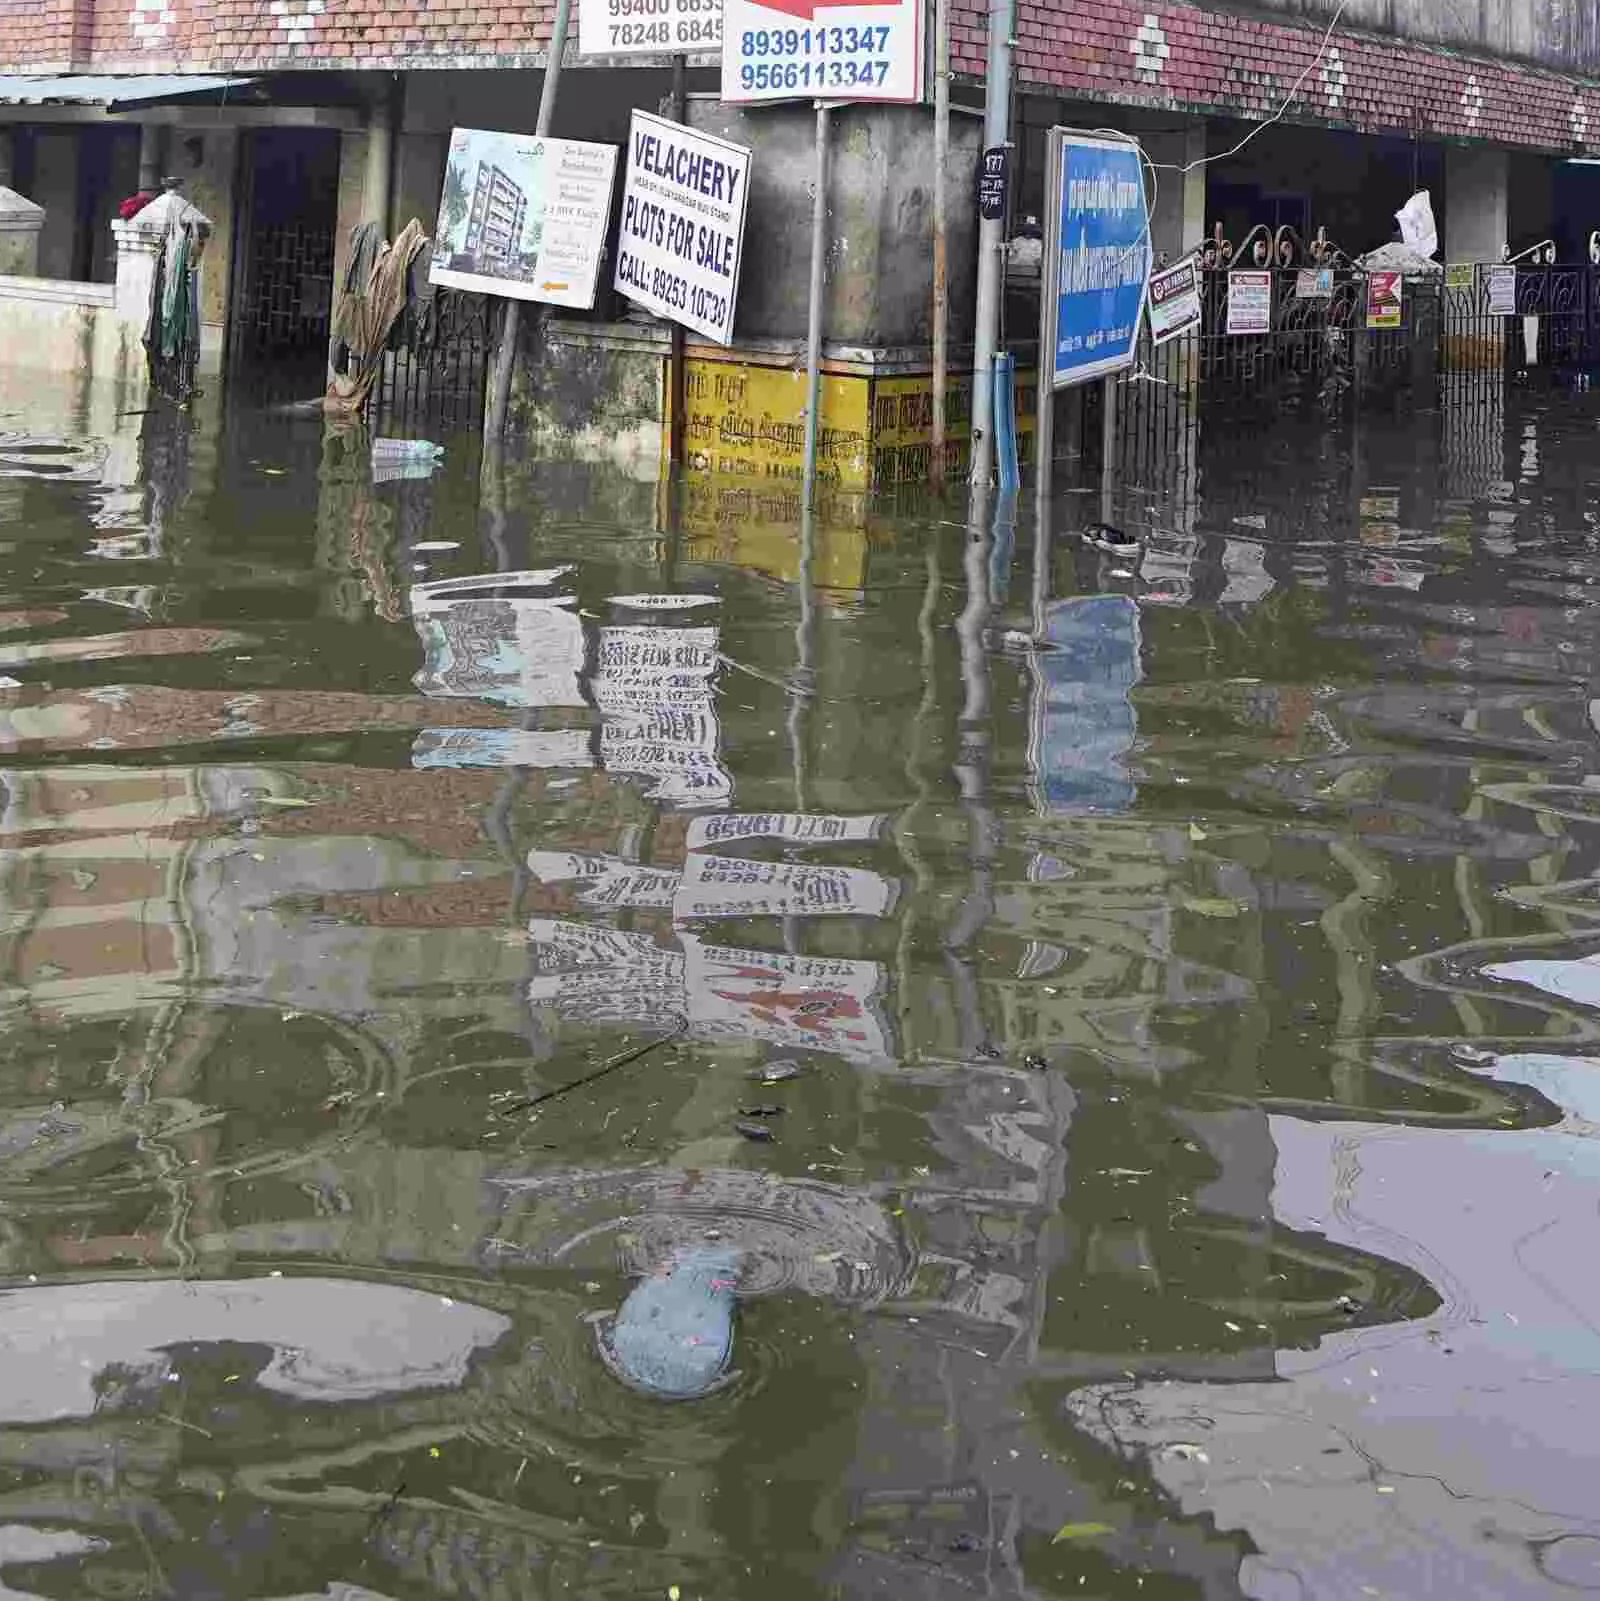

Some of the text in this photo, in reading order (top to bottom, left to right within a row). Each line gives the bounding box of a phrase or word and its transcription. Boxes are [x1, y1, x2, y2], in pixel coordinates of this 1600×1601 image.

[608, 21, 670, 47] 78248
[741, 26, 890, 57] 8939113347
[741, 60, 890, 90] 9566113347
[635, 131, 740, 204] VELACHERY
[624, 195, 666, 247] PLOTS
[667, 211, 695, 261] FOR
[696, 225, 735, 277] SALE
[619, 251, 650, 293] CALL:
[652, 267, 687, 310] 89253
